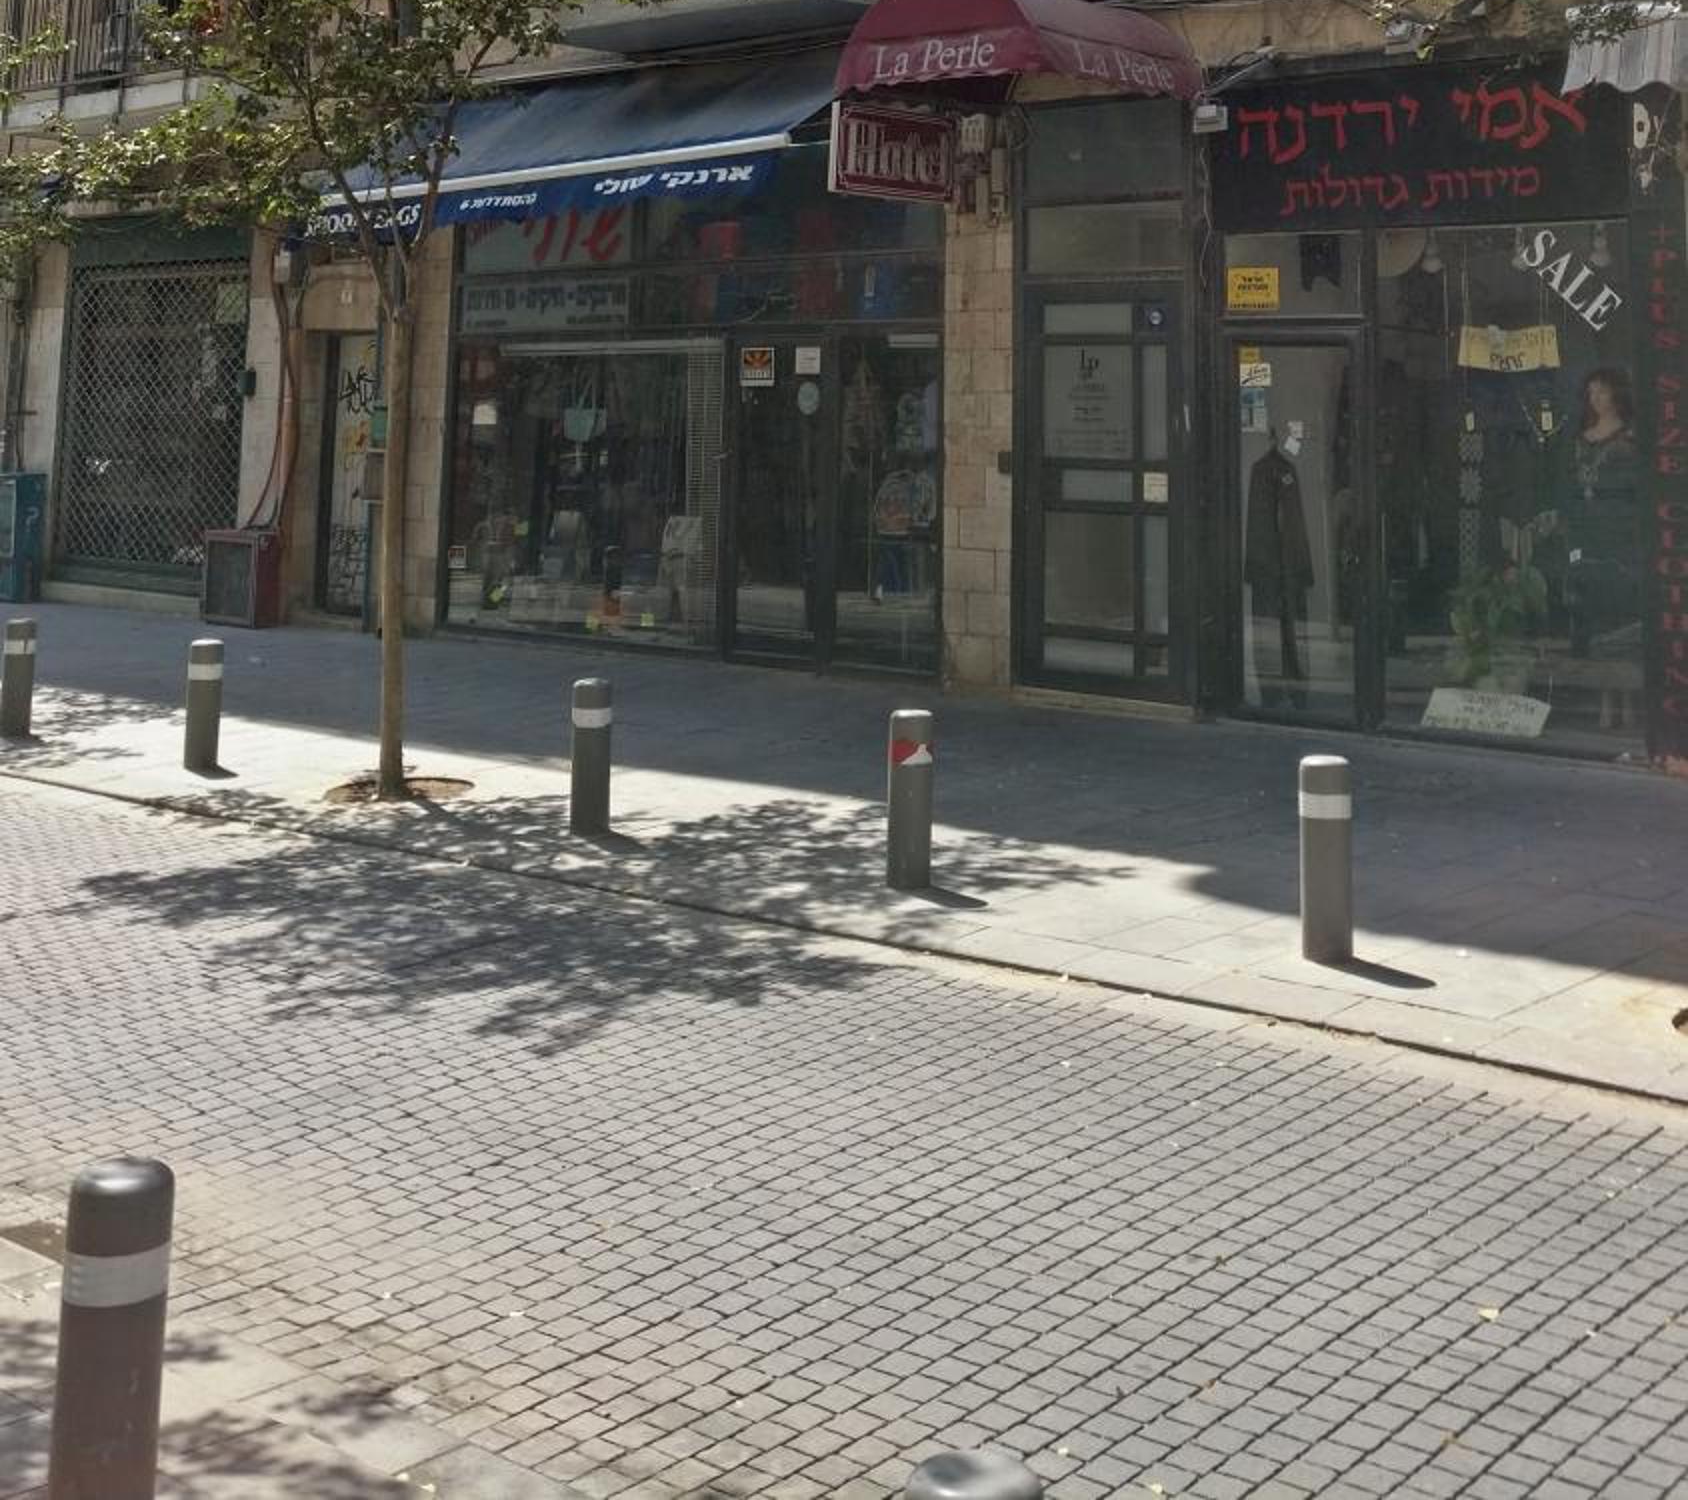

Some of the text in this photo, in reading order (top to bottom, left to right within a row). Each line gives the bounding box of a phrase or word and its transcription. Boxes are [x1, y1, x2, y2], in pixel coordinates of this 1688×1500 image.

[873, 34, 995, 80] La Perle
[1072, 40, 1176, 91] La Perle
[1236, 79, 1586, 165] אמי ירדנה
[594, 164, 754, 195] ארנקי שולי
[1280, 163, 1542, 216] מידות גדולות
[1521, 229, 1623, 331] SALE
